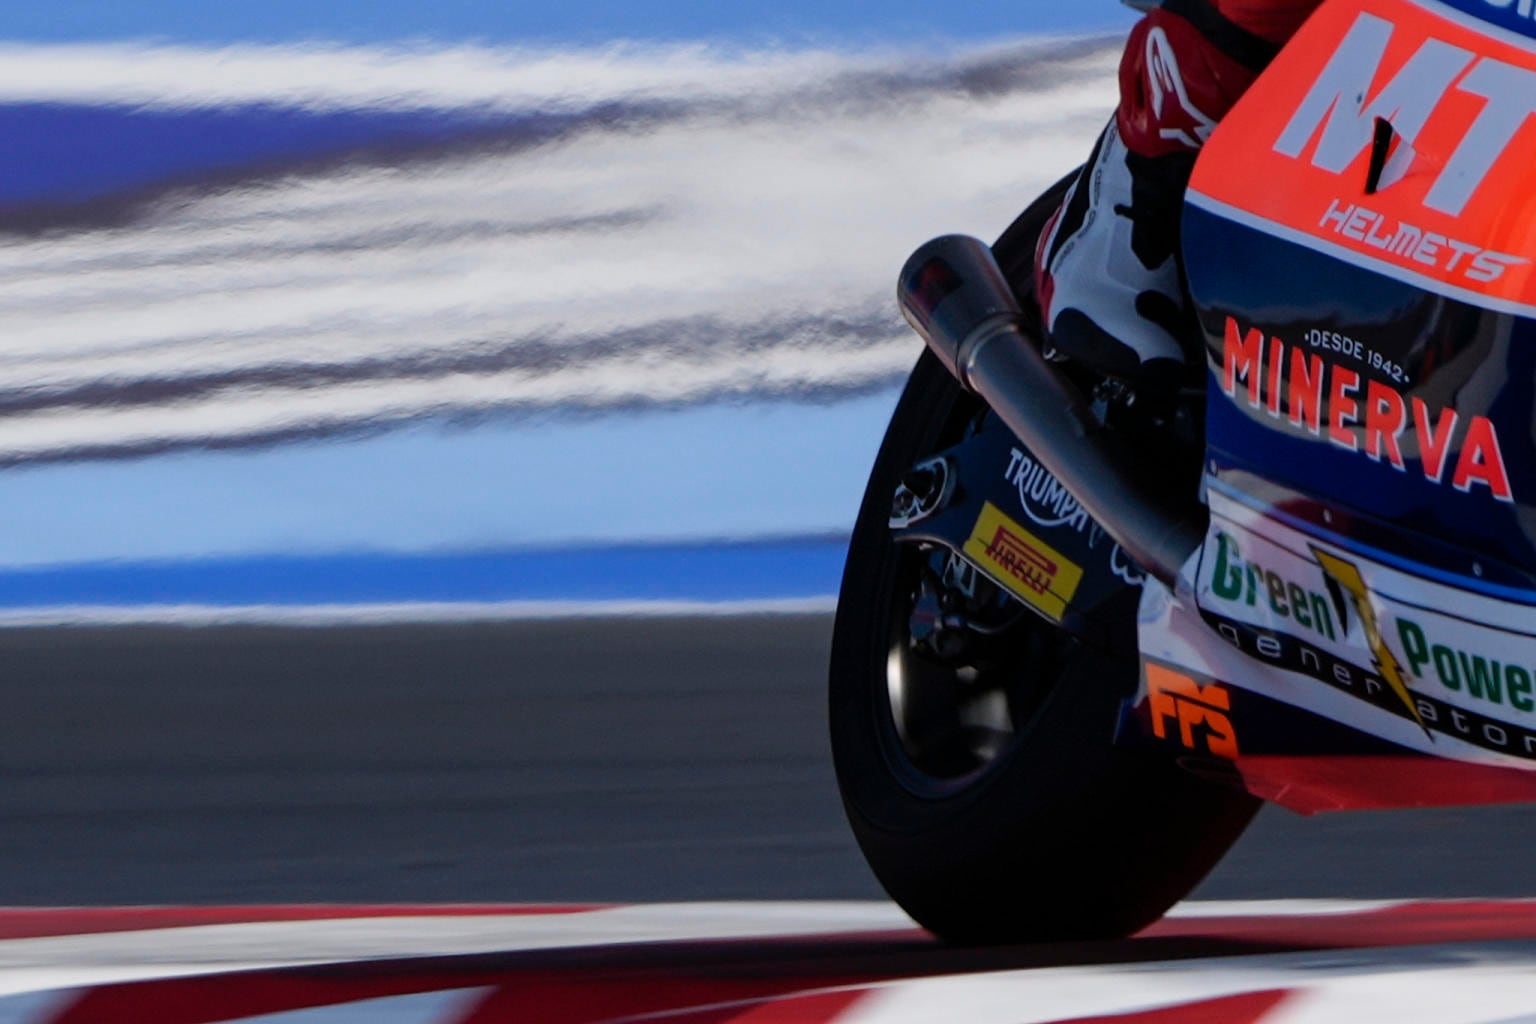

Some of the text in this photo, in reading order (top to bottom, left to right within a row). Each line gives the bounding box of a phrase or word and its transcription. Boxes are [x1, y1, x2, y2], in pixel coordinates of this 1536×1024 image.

[1319, 197, 1533, 284] HELMETS
[1221, 315, 1514, 504] MINERVA
[984, 525, 1059, 596] PIRELLI
[1211, 531, 1337, 645] Green
